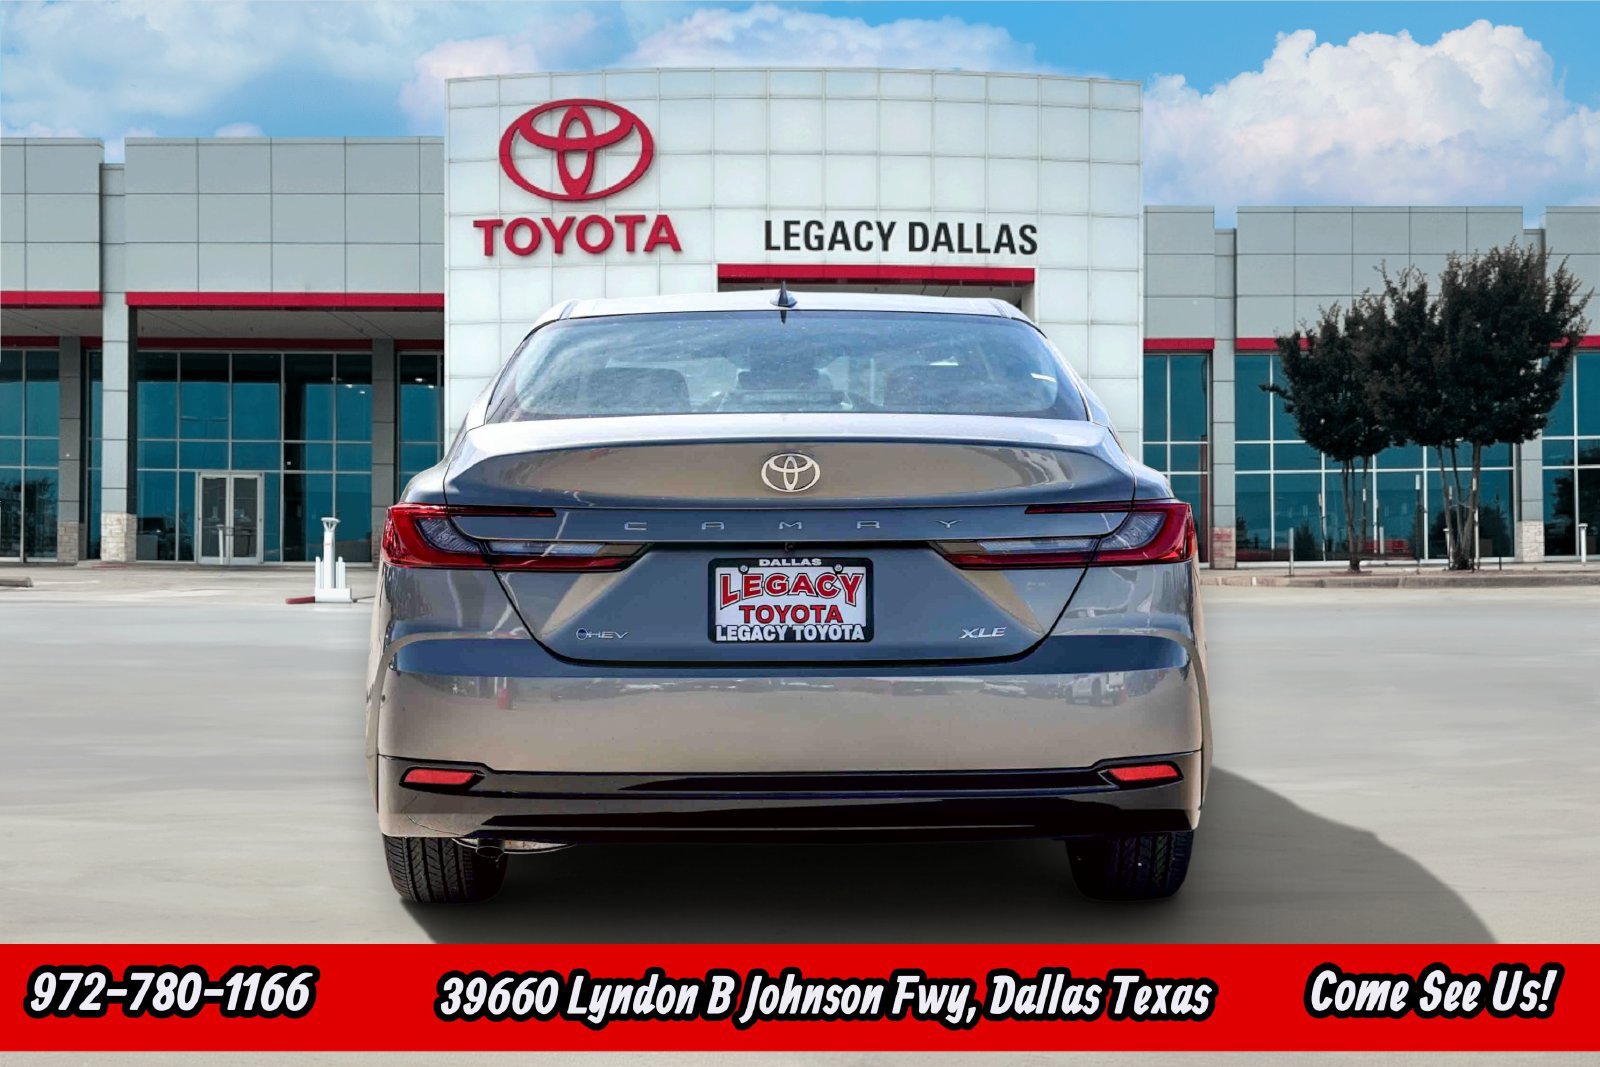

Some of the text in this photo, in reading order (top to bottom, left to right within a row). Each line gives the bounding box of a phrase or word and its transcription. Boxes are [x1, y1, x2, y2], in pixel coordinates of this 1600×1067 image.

[473, 214, 681, 257] TOYOTA
[764, 220, 1038, 255] LEGACY DALLAS
[623, 519, 963, 531] CAMRY
[758, 558, 822, 567] DALLAS
[720, 573, 864, 609] LEGACY
[739, 605, 844, 624] TOYOTA
[716, 624, 865, 641] LEGACY TOYOTA
[959, 626, 1007, 639] XLE
